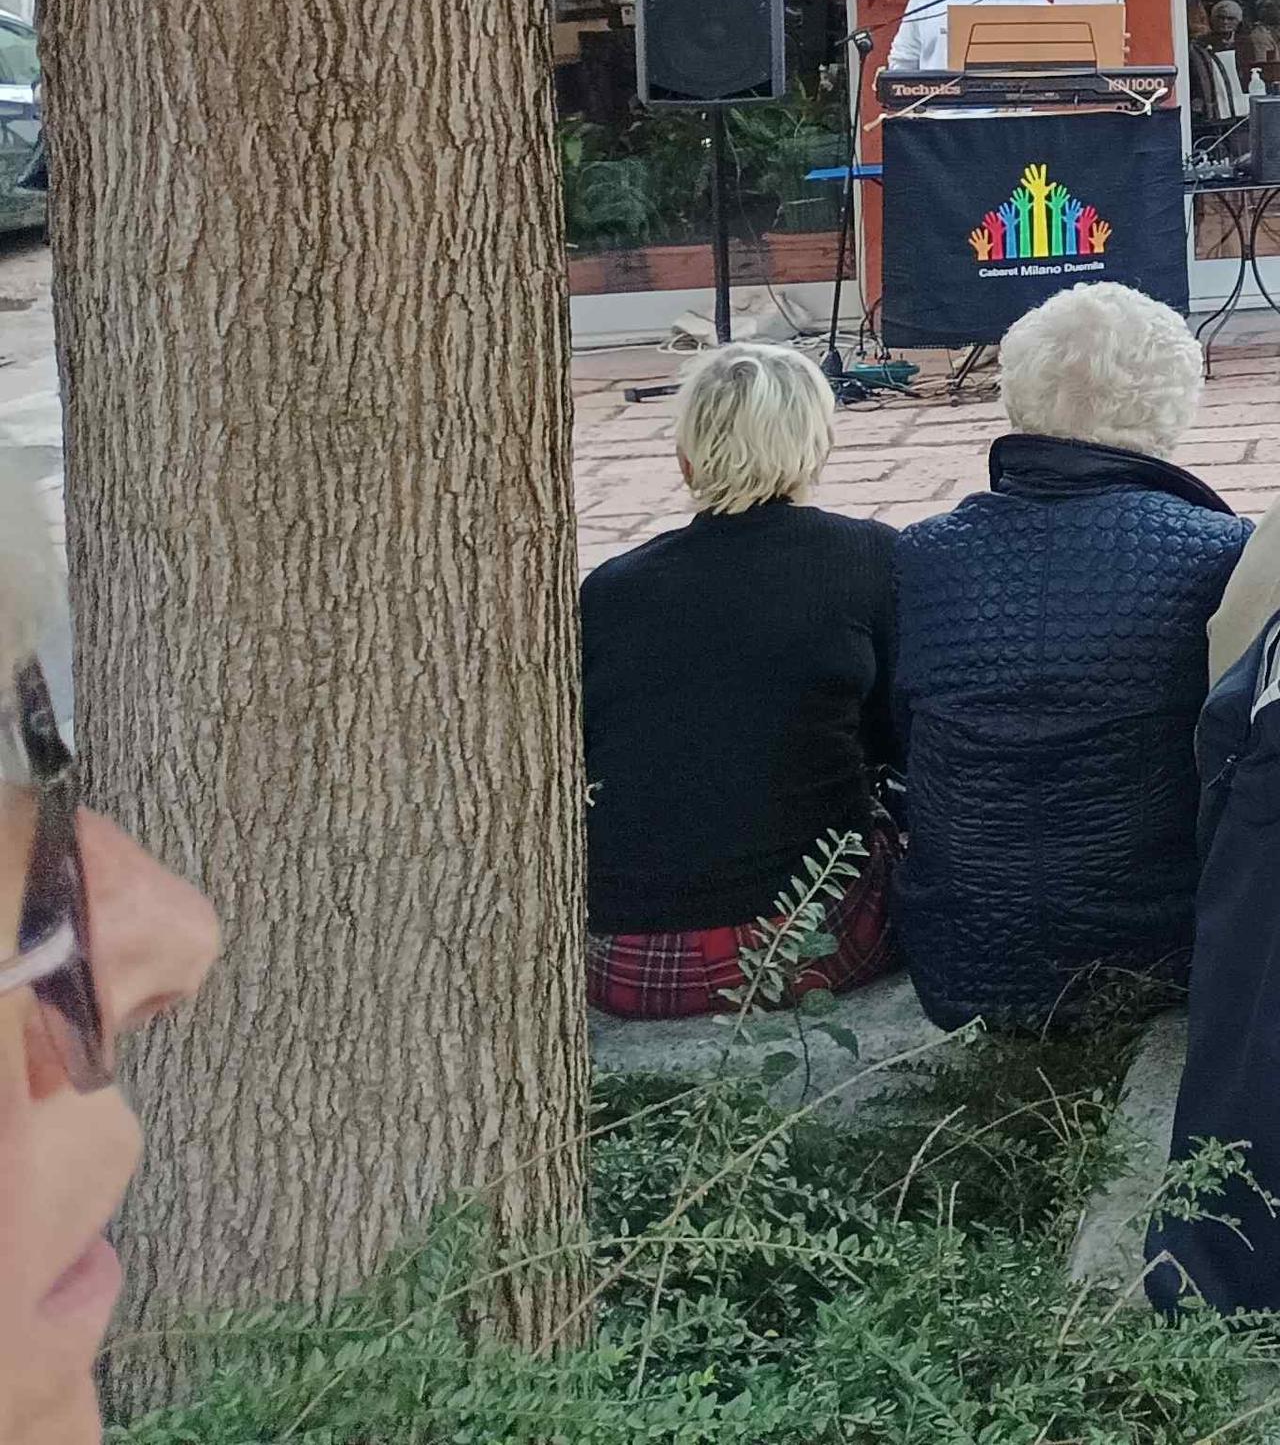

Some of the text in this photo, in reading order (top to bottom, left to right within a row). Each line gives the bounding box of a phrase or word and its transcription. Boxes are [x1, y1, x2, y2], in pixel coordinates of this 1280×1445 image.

[891, 84, 961, 96] Technics
[978, 261, 1105, 278] Cabaret Milano Duemila
